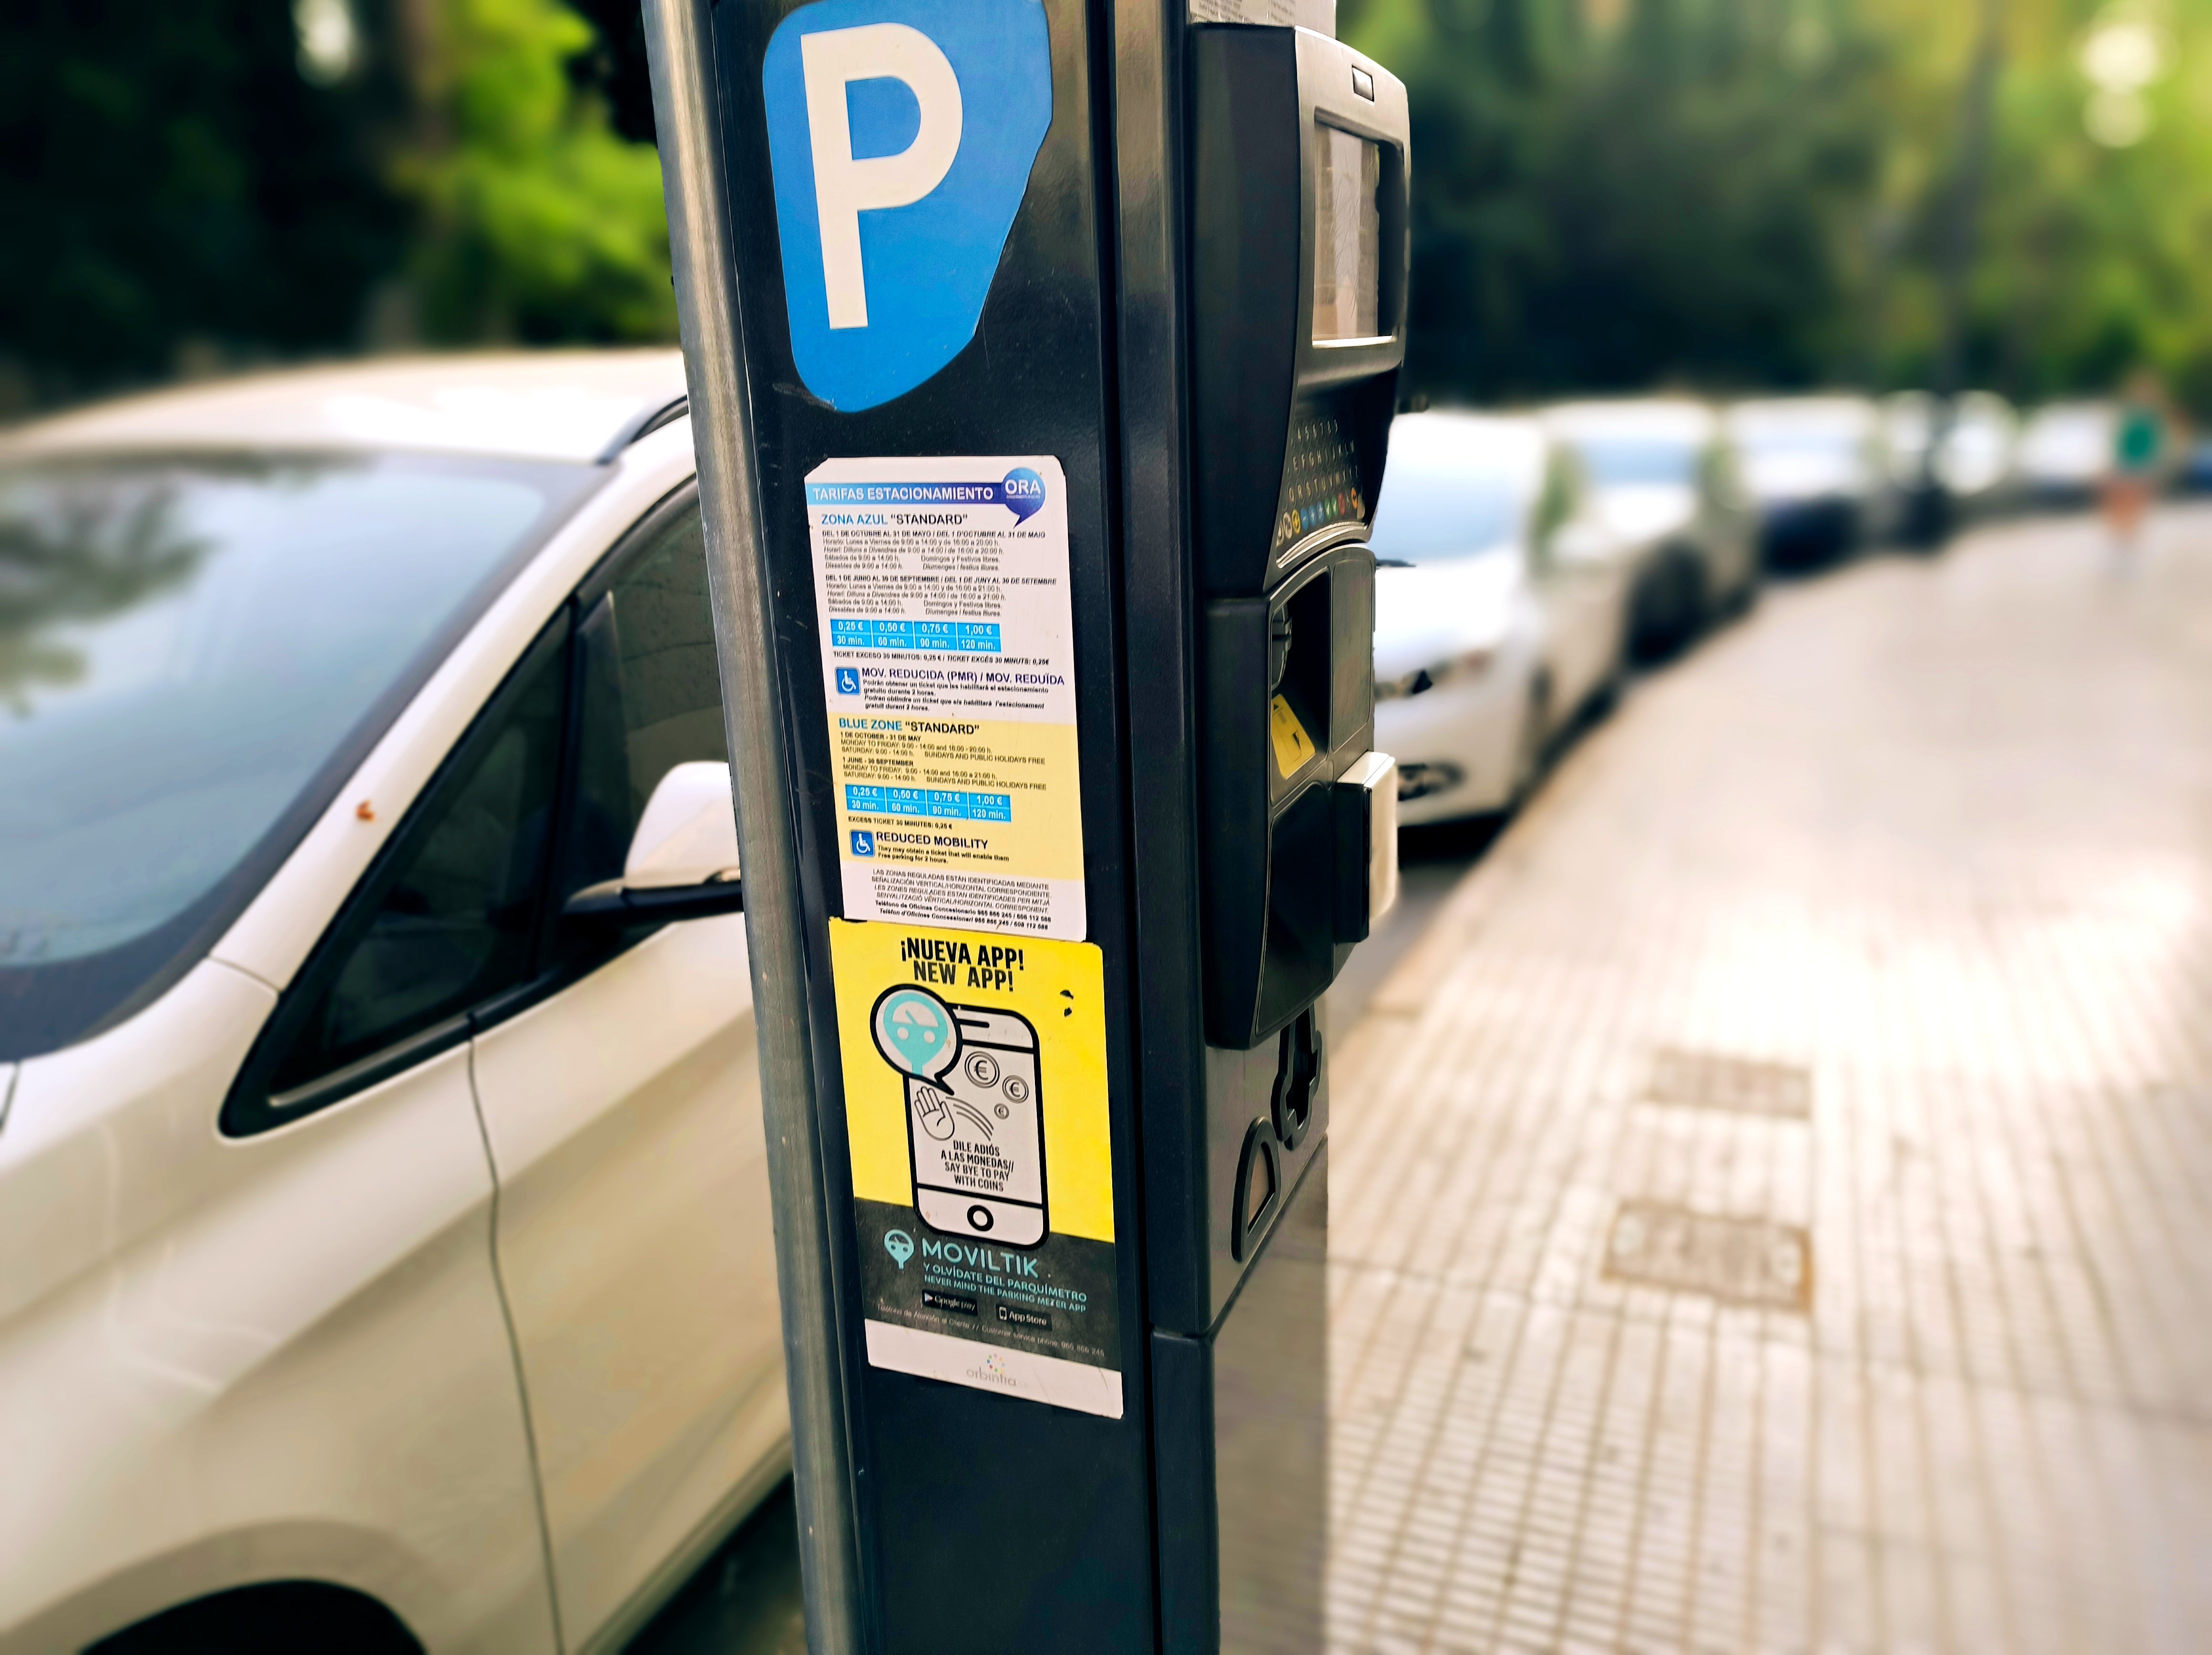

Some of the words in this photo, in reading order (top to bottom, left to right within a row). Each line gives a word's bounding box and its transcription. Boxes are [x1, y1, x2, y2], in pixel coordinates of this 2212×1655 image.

[800, 22, 963, 329] P
[1004, 479, 1041, 494] ORA
[813, 488, 863, 500] TARIFAS
[868, 487, 992, 500] ESTACIONAMIENTO
[821, 513, 853, 524] ZONA
[857, 513, 888, 525] AZUL
[838, 621, 855, 632] 0,25
[858, 622, 863, 631] €
[880, 622, 897, 633] 0,50
[900, 623, 905, 632] €
[922, 623, 940, 633] 0,75
[942, 623, 948, 633] €
[965, 624, 983, 635] 1,00
[986, 625, 992, 634] €
[837, 635, 846, 644] 30
[848, 636, 864, 644] min.
[878, 636, 887, 645] 60
[890, 637, 906, 646] min.
[920, 638, 929, 647] 90
[932, 639, 949, 648] min.
[962, 639, 975, 649] 120
[978, 640, 994, 649] min.
[862, 667, 886, 677] MOV.
[889, 668, 944, 680] REDUCIDA
[947, 670, 977, 683] (PMR)
[986, 672, 1012, 683] MOV.
[839, 717, 868, 729] BLUE
[870, 719, 902, 731] ZONE
[876, 758, 913, 766] SEPTEMBER
[853, 787, 870, 797] 0,25
[872, 787, 877, 797] €
[893, 789, 910, 800] 0,50
[912, 790, 918, 799] €
[934, 792, 952, 802] 0,75
[954, 793, 959, 802] €
[852, 800, 860, 808] 30
[862, 801, 878, 809] min.
[977, 795, 994, 806] 1,00
[997, 796, 1002, 805] €
[891, 803, 901, 811] 60
[903, 804, 919, 813] min.
[932, 806, 942, 814] 90
[944, 807, 960, 816] min.
[973, 808, 986, 817] 120
[988, 810, 1005, 819] min.
[848, 815, 871, 823] EXCESS
[876, 831, 930, 844] REDUCED
[934, 836, 987, 849] MOBILITY
[901, 937, 972, 965] ¡NUEVA
[977, 945, 1024, 970] APP!
[914, 960, 956, 984] NEW
[967, 967, 1014, 992] APP!
[953, 1139, 971, 1153] DILE
[973, 1141, 1000, 1157] ADIÓS
[940, 1149, 946, 1160] A
[948, 1150, 964, 1163] LAS
[944, 1161, 961, 1174] SAY
[963, 1164, 978, 1176] BYE
[980, 1166, 991, 1178] TO
[993, 1168, 1010, 1182] PAY
[954, 1174, 975, 1187] WITH
[977, 1177, 1004, 1192] COINS
[922, 1237, 1039, 1279] MOVILTIK
[923, 1261, 931, 1272] Y
[932, 1263, 982, 1283] OLVÍDATE
[985, 1273, 1005, 1287] DEL
[1008, 1278, 1087, 1302] PARQUÍMETRO
[924, 1273, 952, 1287] NEVER
[953, 1279, 976, 1292] MIND
[979, 1284, 994, 1296] THE
[997, 1287, 1035, 1304] PARKING
[1037, 1295, 1066, 1310] METER
[1068, 1301, 1086, 1314] APP
[935, 1295, 960, 1309] Google
[1009, 1311, 1025, 1323] App
[1026, 1314, 1047, 1325] Store
